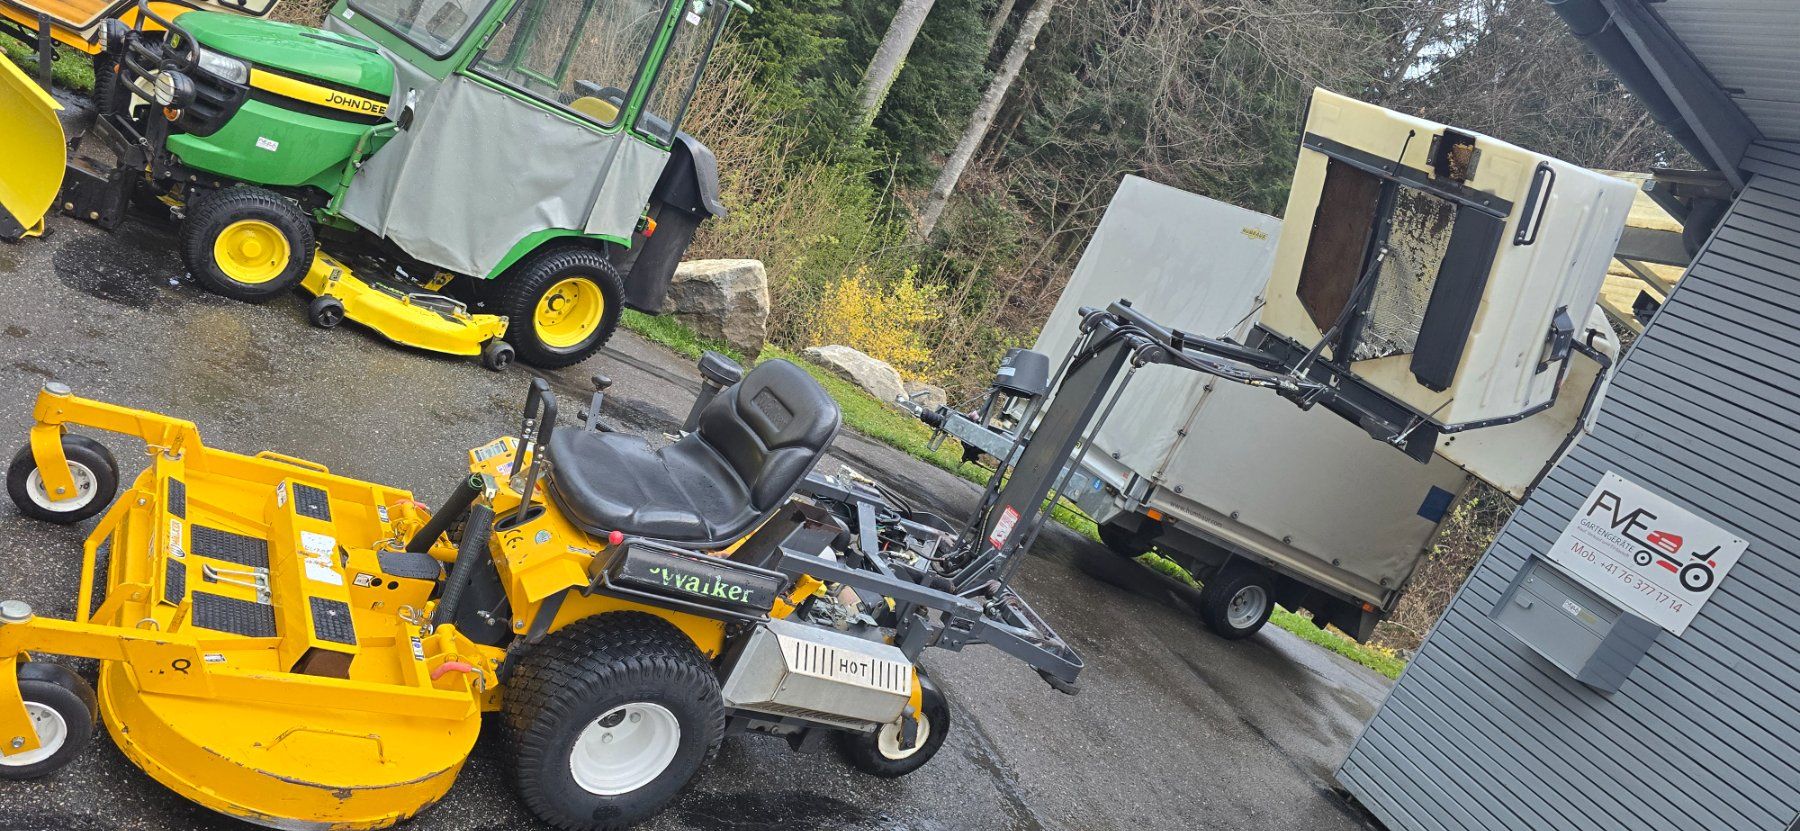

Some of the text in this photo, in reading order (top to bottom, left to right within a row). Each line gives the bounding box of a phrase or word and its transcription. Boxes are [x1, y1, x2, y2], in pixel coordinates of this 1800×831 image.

[325, 92, 361, 109] JOHN
[1586, 489, 1658, 535] FVE
[1579, 517, 1635, 552] GARTENGERÄTE
[1570, 542, 1683, 613] Mob. +41 76 377 17 14
[839, 658, 868, 677] HOT
